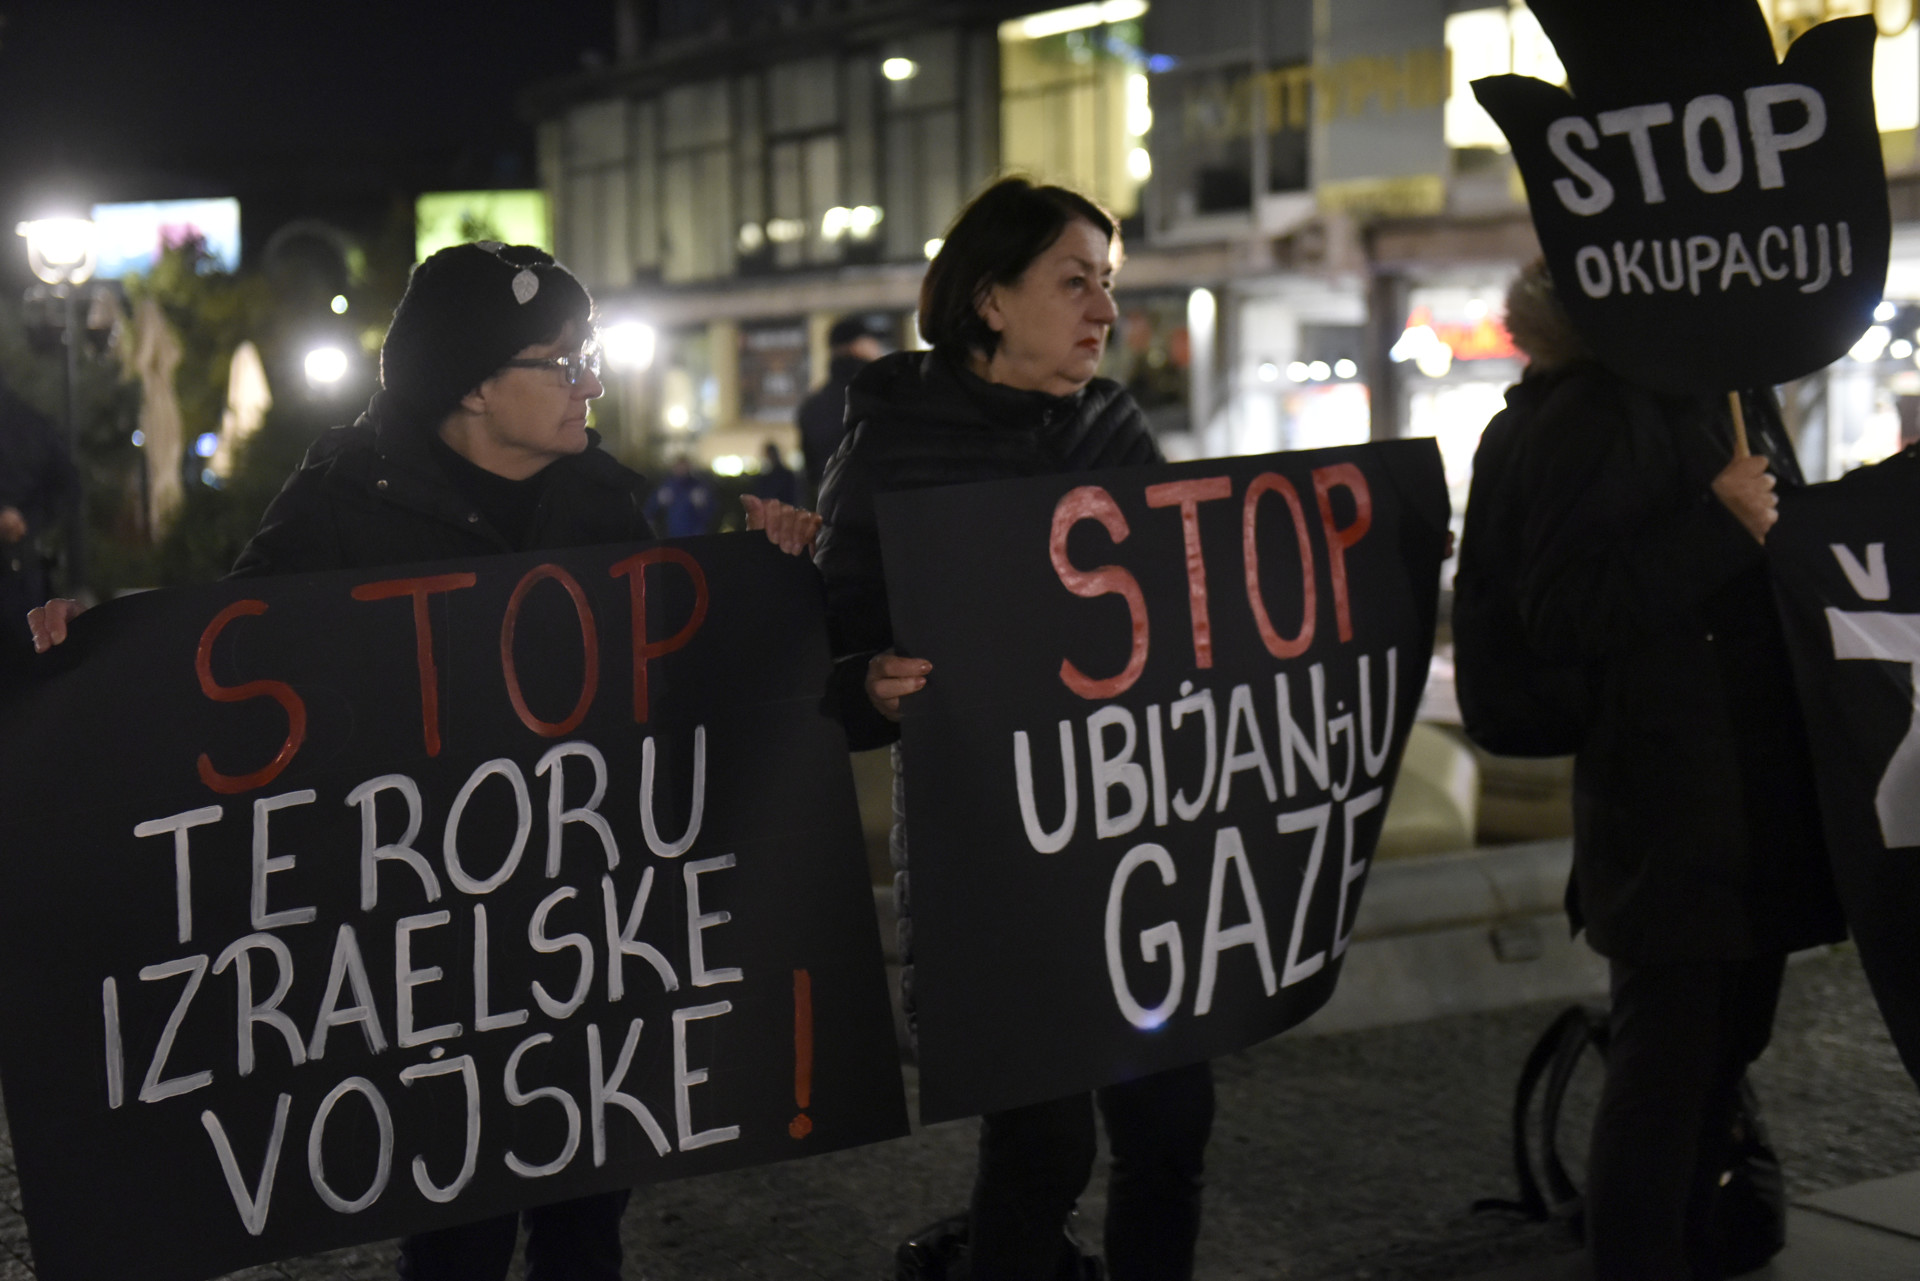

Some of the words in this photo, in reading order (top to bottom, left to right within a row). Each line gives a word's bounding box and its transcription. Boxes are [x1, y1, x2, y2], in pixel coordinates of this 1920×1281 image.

[1547, 84, 1827, 216] STOP
[1576, 222, 1852, 298] OKUPACIJI
[196, 548, 708, 793] STOP
[1050, 463, 1372, 700] STOP
[135, 726, 705, 943] TERORU
[1105, 787, 1382, 1029] GAZE
[102, 855, 743, 1108] IZRAELSKE
[202, 1002, 740, 1235] VOJSKE
